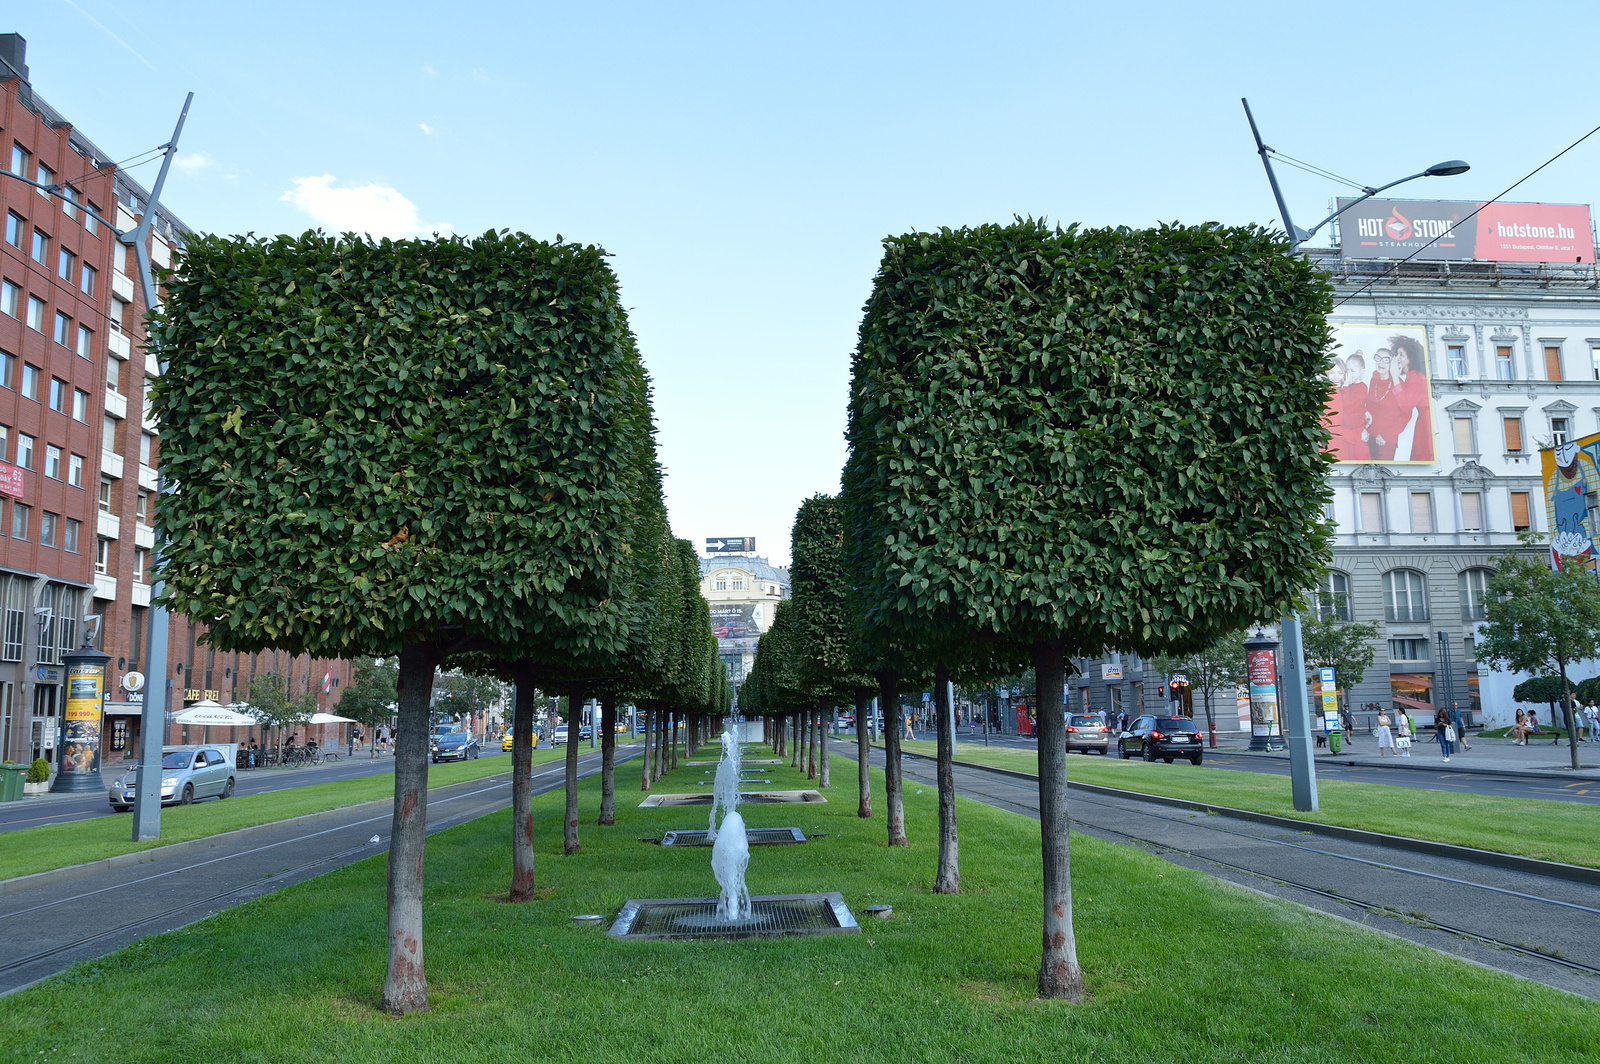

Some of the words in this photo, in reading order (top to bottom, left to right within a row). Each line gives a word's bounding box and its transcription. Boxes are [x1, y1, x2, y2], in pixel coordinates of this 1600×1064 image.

[1358, 218, 1383, 237] HOT
[1413, 219, 1455, 238] STONE
[1497, 221, 1575, 239] hotstone.hu
[13, 470, 22, 482] 62
[183, 689, 200, 701] CAFE
[204, 689, 219, 701] FREI
